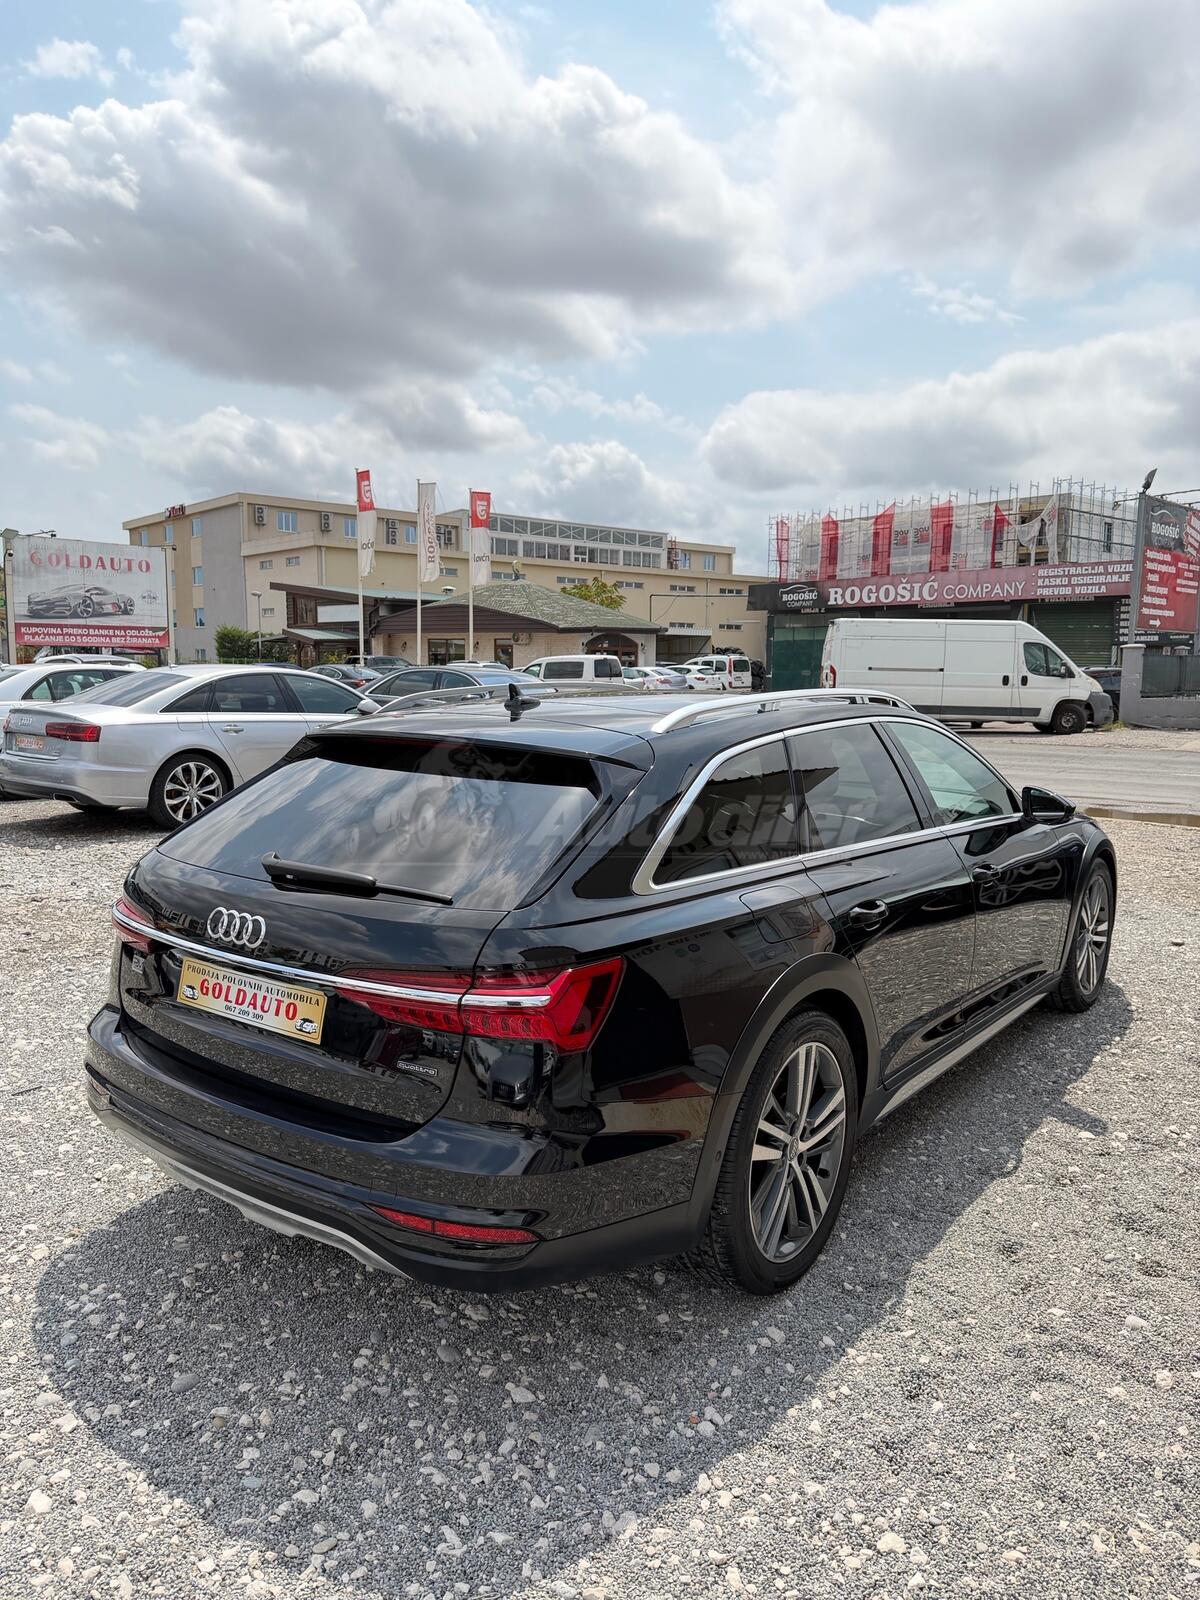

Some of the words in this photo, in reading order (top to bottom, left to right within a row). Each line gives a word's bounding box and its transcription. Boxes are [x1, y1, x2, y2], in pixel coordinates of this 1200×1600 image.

[30, 550, 151, 573] GOLDAUTO
[1037, 565, 1104, 577] REGISTRACIJA
[1107, 563, 1134, 573] VOZIL
[1037, 577, 1068, 586] KASKO
[1071, 574, 1131, 584] OSIGURANJE
[782, 591, 818, 601] ROGOŠIĆ
[828, 576, 939, 605] ROGOŠIĆ
[943, 581, 1026, 599] COMPANY
[1036, 586, 1072, 596] PREVOD
[1075, 585, 1107, 594] VOZILA
[21, 626, 62, 634] KUPOVINA
[24, 634, 64, 642] PLAĆANJE
[127, 636, 160, 644] ŽIRANATA
[187, 964, 220, 981] PRODAJA
[222, 974, 263, 992] POLOVNIH
[264, 986, 320, 1007] AUTOMOBILA
[199, 978, 298, 1021] GOLDAUTO
[224, 1004, 237, 1014] 067
[237, 1008, 250, 1017] 209
[251, 1012, 264, 1021] 309
[398, 1062, 435, 1075] quattro
